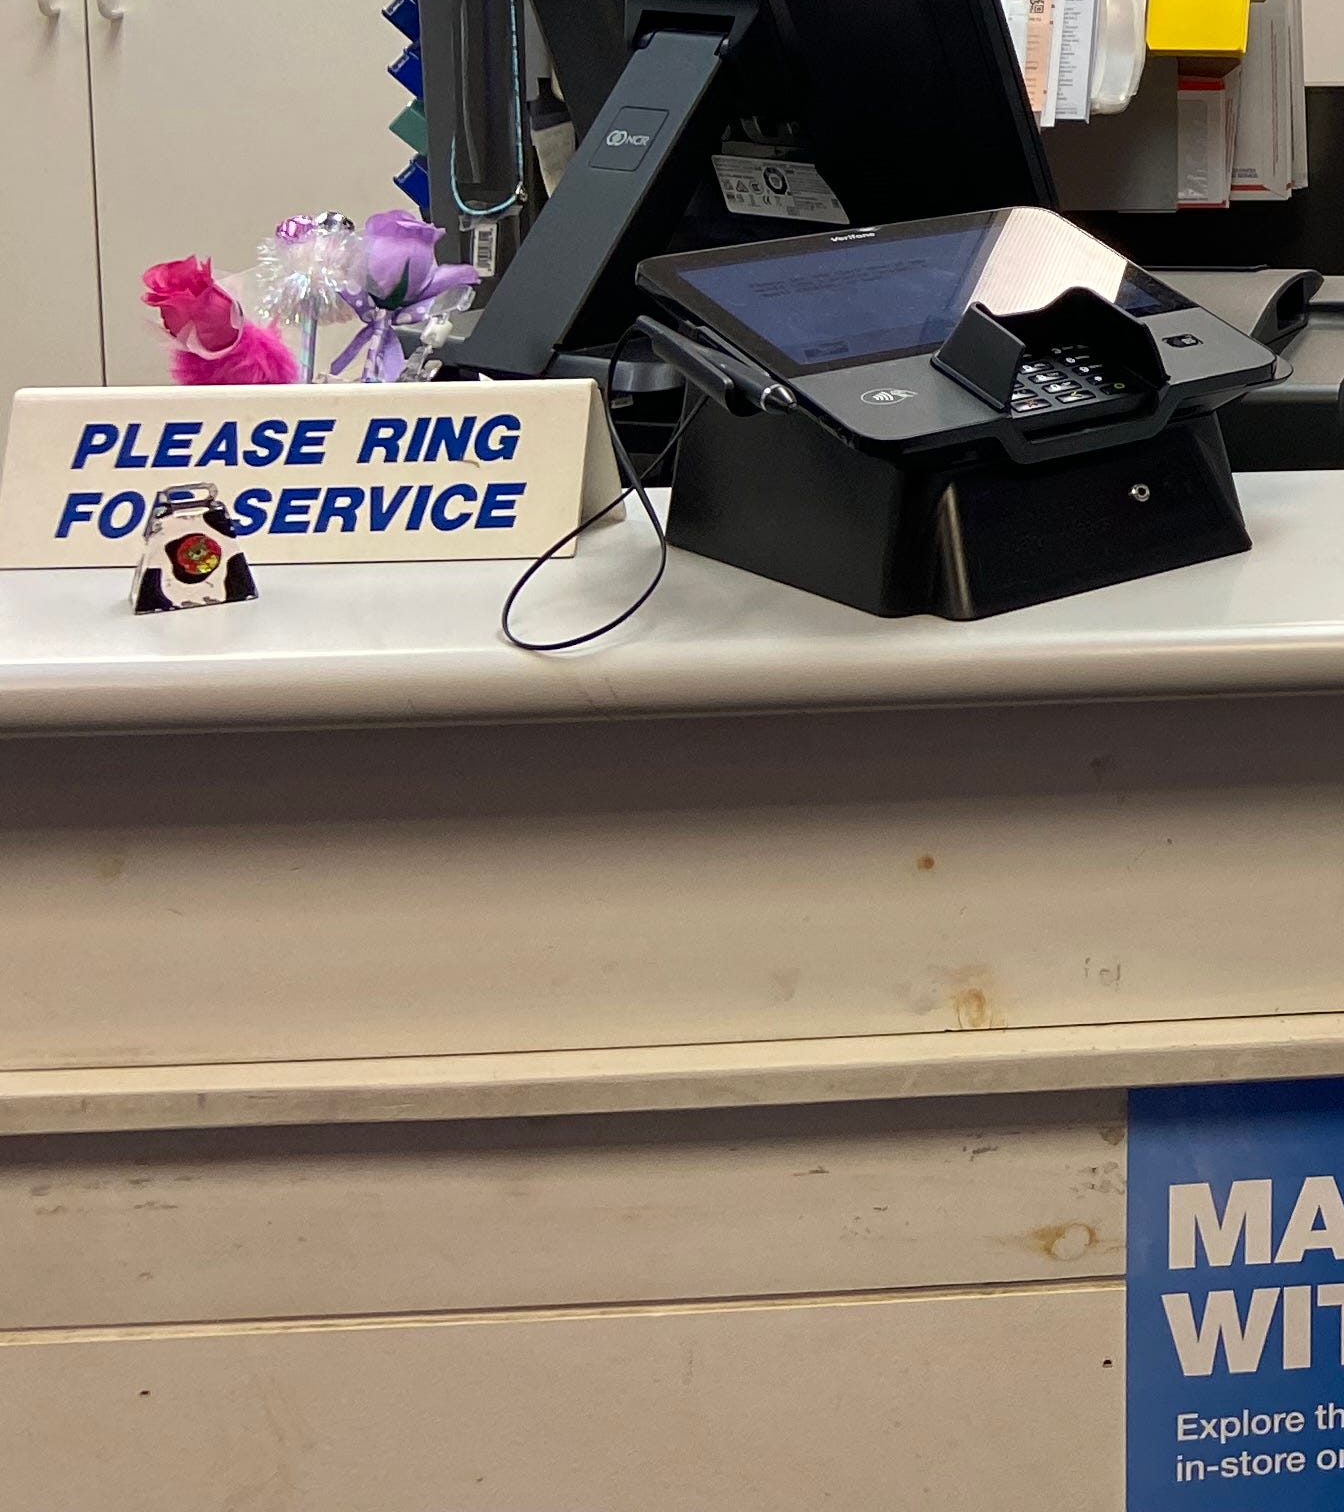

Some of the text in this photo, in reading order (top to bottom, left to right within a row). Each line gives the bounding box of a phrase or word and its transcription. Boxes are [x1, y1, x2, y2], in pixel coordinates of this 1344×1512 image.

[625, 135, 650, 146] NCR
[830, 232, 875, 242] Verifone
[71, 413, 522, 471] PLEASE RING
[54, 481, 527, 539] FO SERVICE
[1175, 1408, 1305, 1444] Explore
[1175, 1450, 1306, 1483] in-store
